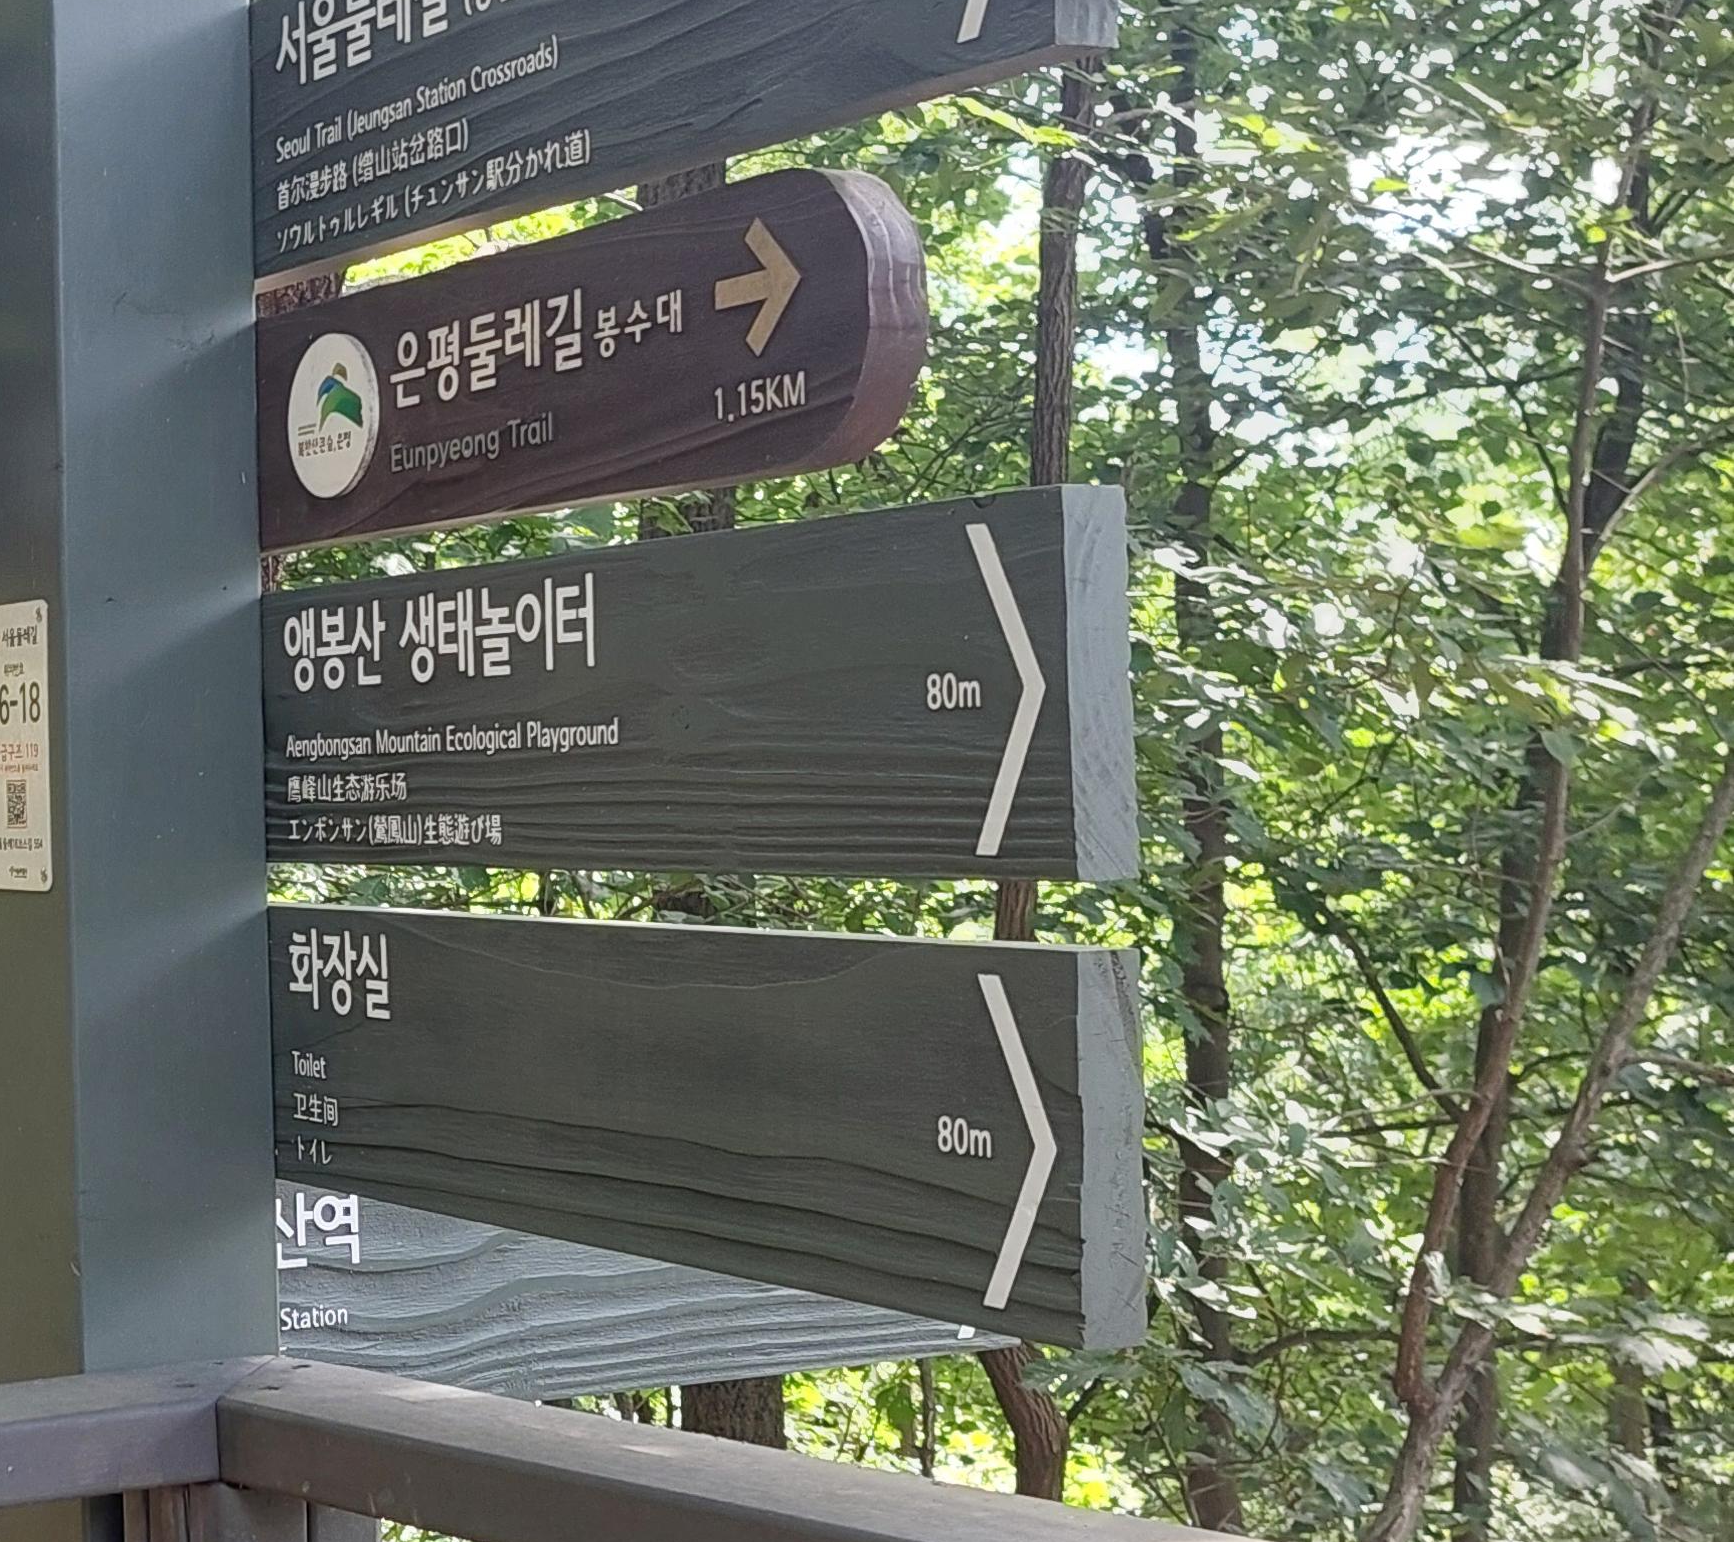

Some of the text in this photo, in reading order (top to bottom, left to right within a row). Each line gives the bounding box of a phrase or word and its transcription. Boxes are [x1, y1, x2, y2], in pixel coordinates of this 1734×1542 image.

[275, 34, 560, 163] Seoul Trail (Jeungsan Station Crossroads)
[276, 160, 346, 210] 首尔漫步路
[388, 288, 684, 410] 은평둘레길 봉수대
[713, 371, 807, 424] 1.15KM
[389, 412, 554, 474] Eunpyeong Trail
[283, 572, 596, 693] 앵봉산 생태놀이터
[926, 672, 982, 710] 80m
[286, 717, 619, 761] Aengbongsan Mountain Ecological Playground
[288, 928, 392, 1020] 화장실
[291, 1050, 327, 1079] Toilet
[293, 1092, 339, 1127] 卫生间
[297, 1135, 333, 1165] トイレ
[937, 1115, 993, 1159] 80m
[280, 1305, 348, 1332] Station
